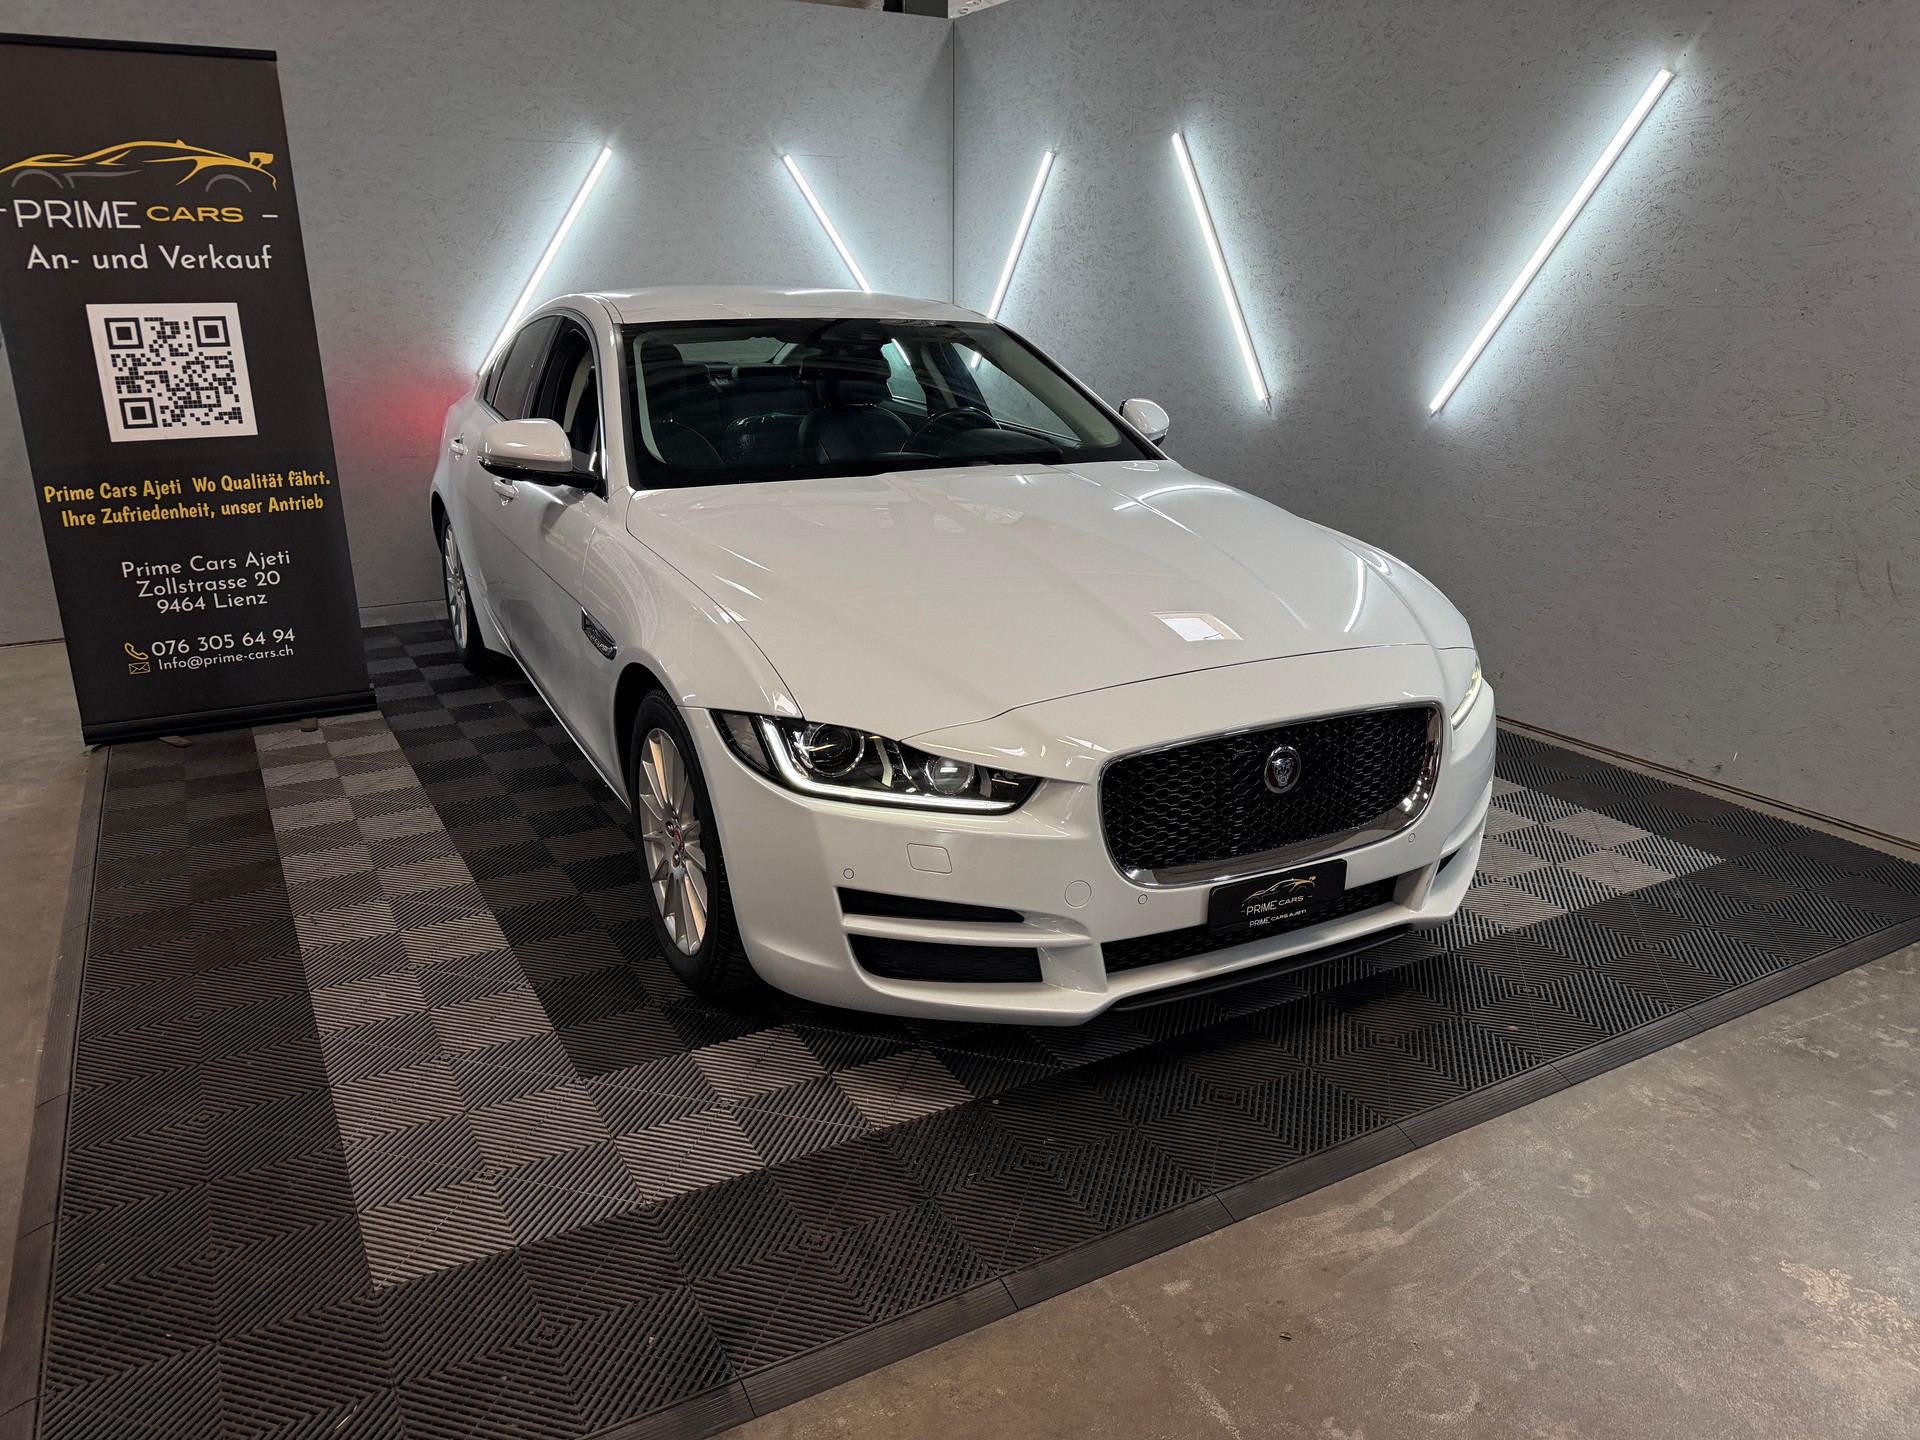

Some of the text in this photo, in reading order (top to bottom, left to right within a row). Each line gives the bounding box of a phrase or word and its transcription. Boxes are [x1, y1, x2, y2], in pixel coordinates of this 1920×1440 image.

[13, 199, 244, 229] PRIME CARS
[27, 243, 272, 270] An- und Verkauf
[44, 470, 331, 503] Prime Cars Ajeti Wo Qualität fährt.
[61, 493, 324, 527] Ihre Zufriedenheit, unser Antrieb
[121, 550, 291, 578] Prime Cars Ajeti
[136, 570, 281, 598] Zollstrasse 20
[156, 592, 268, 614] 9464 Lienz
[151, 628, 296, 656] 076 305 64 94
[158, 644, 294, 671] Info@prime-cars.ch
[1246, 895, 1304, 916] PRIME CARS
[1249, 909, 1307, 928] PRIME CARS AJETI
